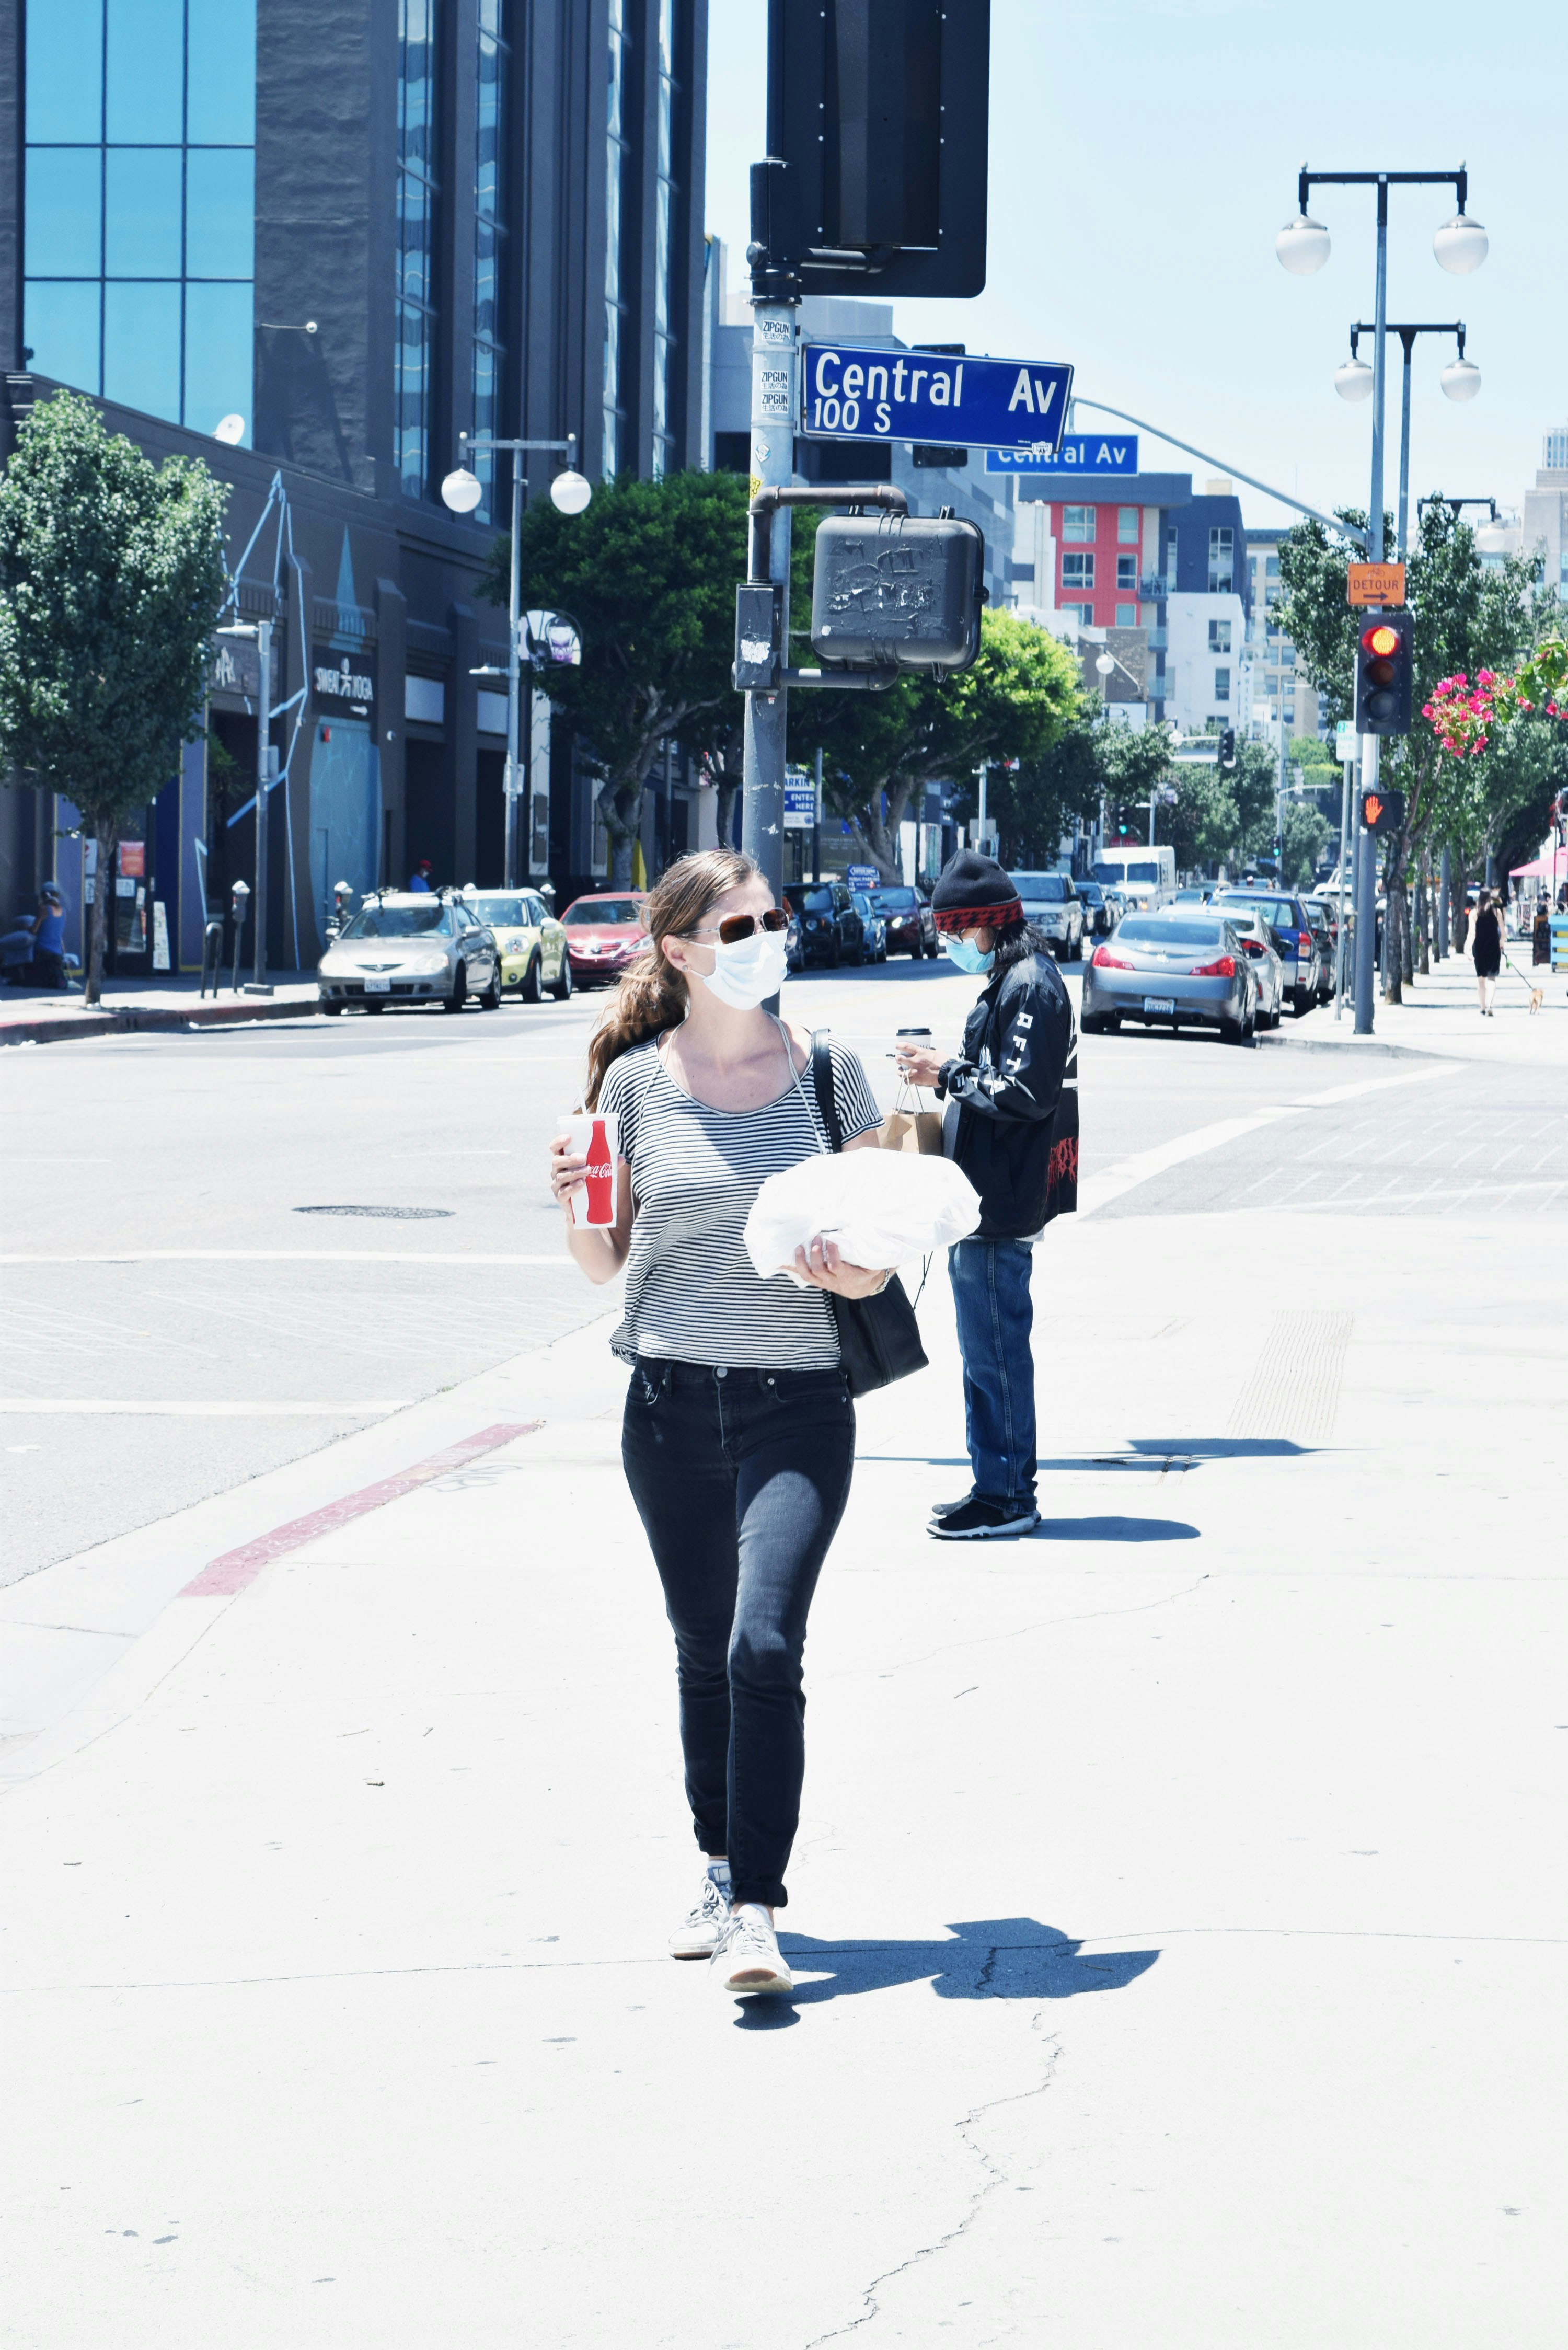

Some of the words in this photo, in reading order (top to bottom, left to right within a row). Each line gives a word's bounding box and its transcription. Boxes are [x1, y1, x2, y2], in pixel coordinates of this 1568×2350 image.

[763, 321, 789, 334] ZIPGUN
[762, 372, 787, 382] ZIPGUN
[815, 352, 963, 407] Central
[1008, 368, 1057, 414] Av
[762, 394, 788, 405] ZIPGUN
[814, 398, 860, 431] 100
[874, 402, 891, 433] S
[1096, 443, 1126, 464] Av
[1353, 579, 1399, 590] DETOUR
